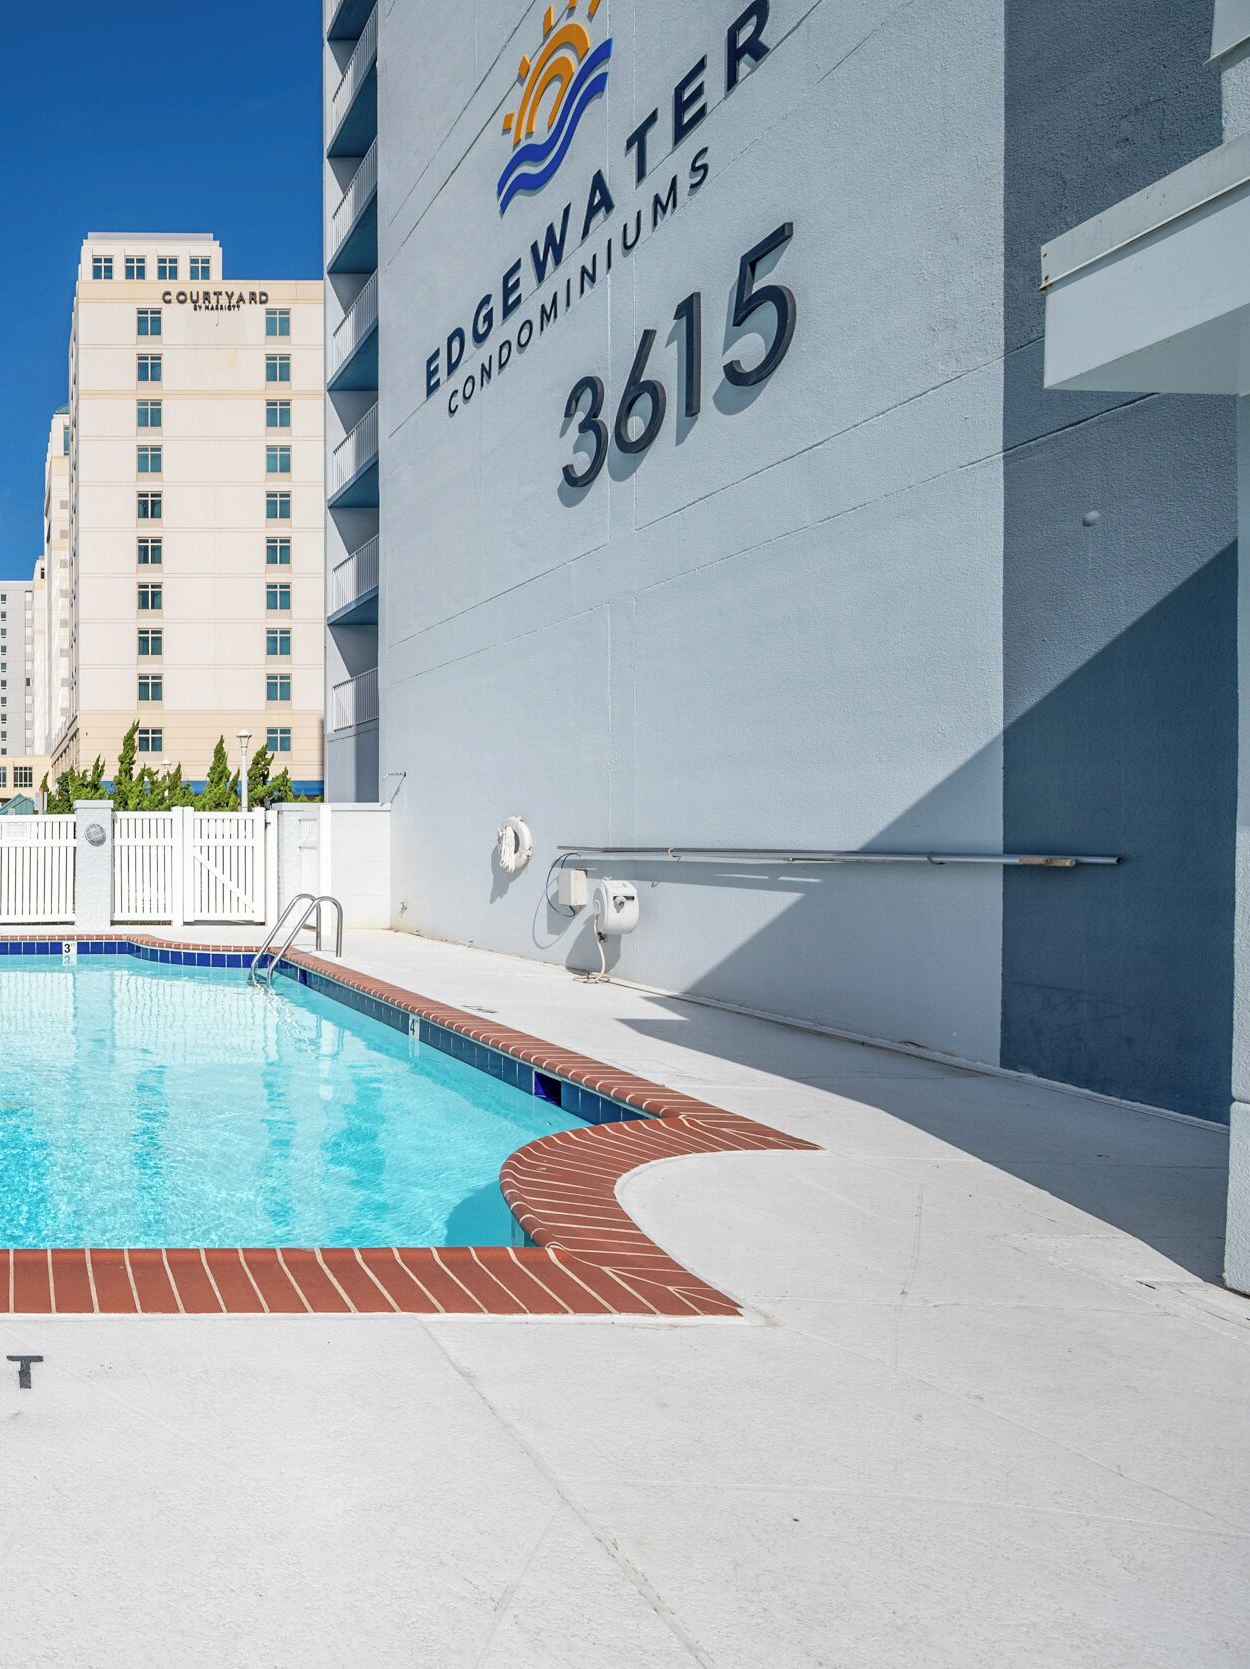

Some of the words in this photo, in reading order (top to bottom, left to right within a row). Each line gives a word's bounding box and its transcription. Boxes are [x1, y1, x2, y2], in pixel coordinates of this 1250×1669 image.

[161, 290, 269, 304] COURTYARD
[425, 0, 771, 400] EDGEWATER
[448, 147, 710, 416] CONDOMINIUMS
[562, 222, 796, 487] 3615
[64, 943, 71, 953] 3
